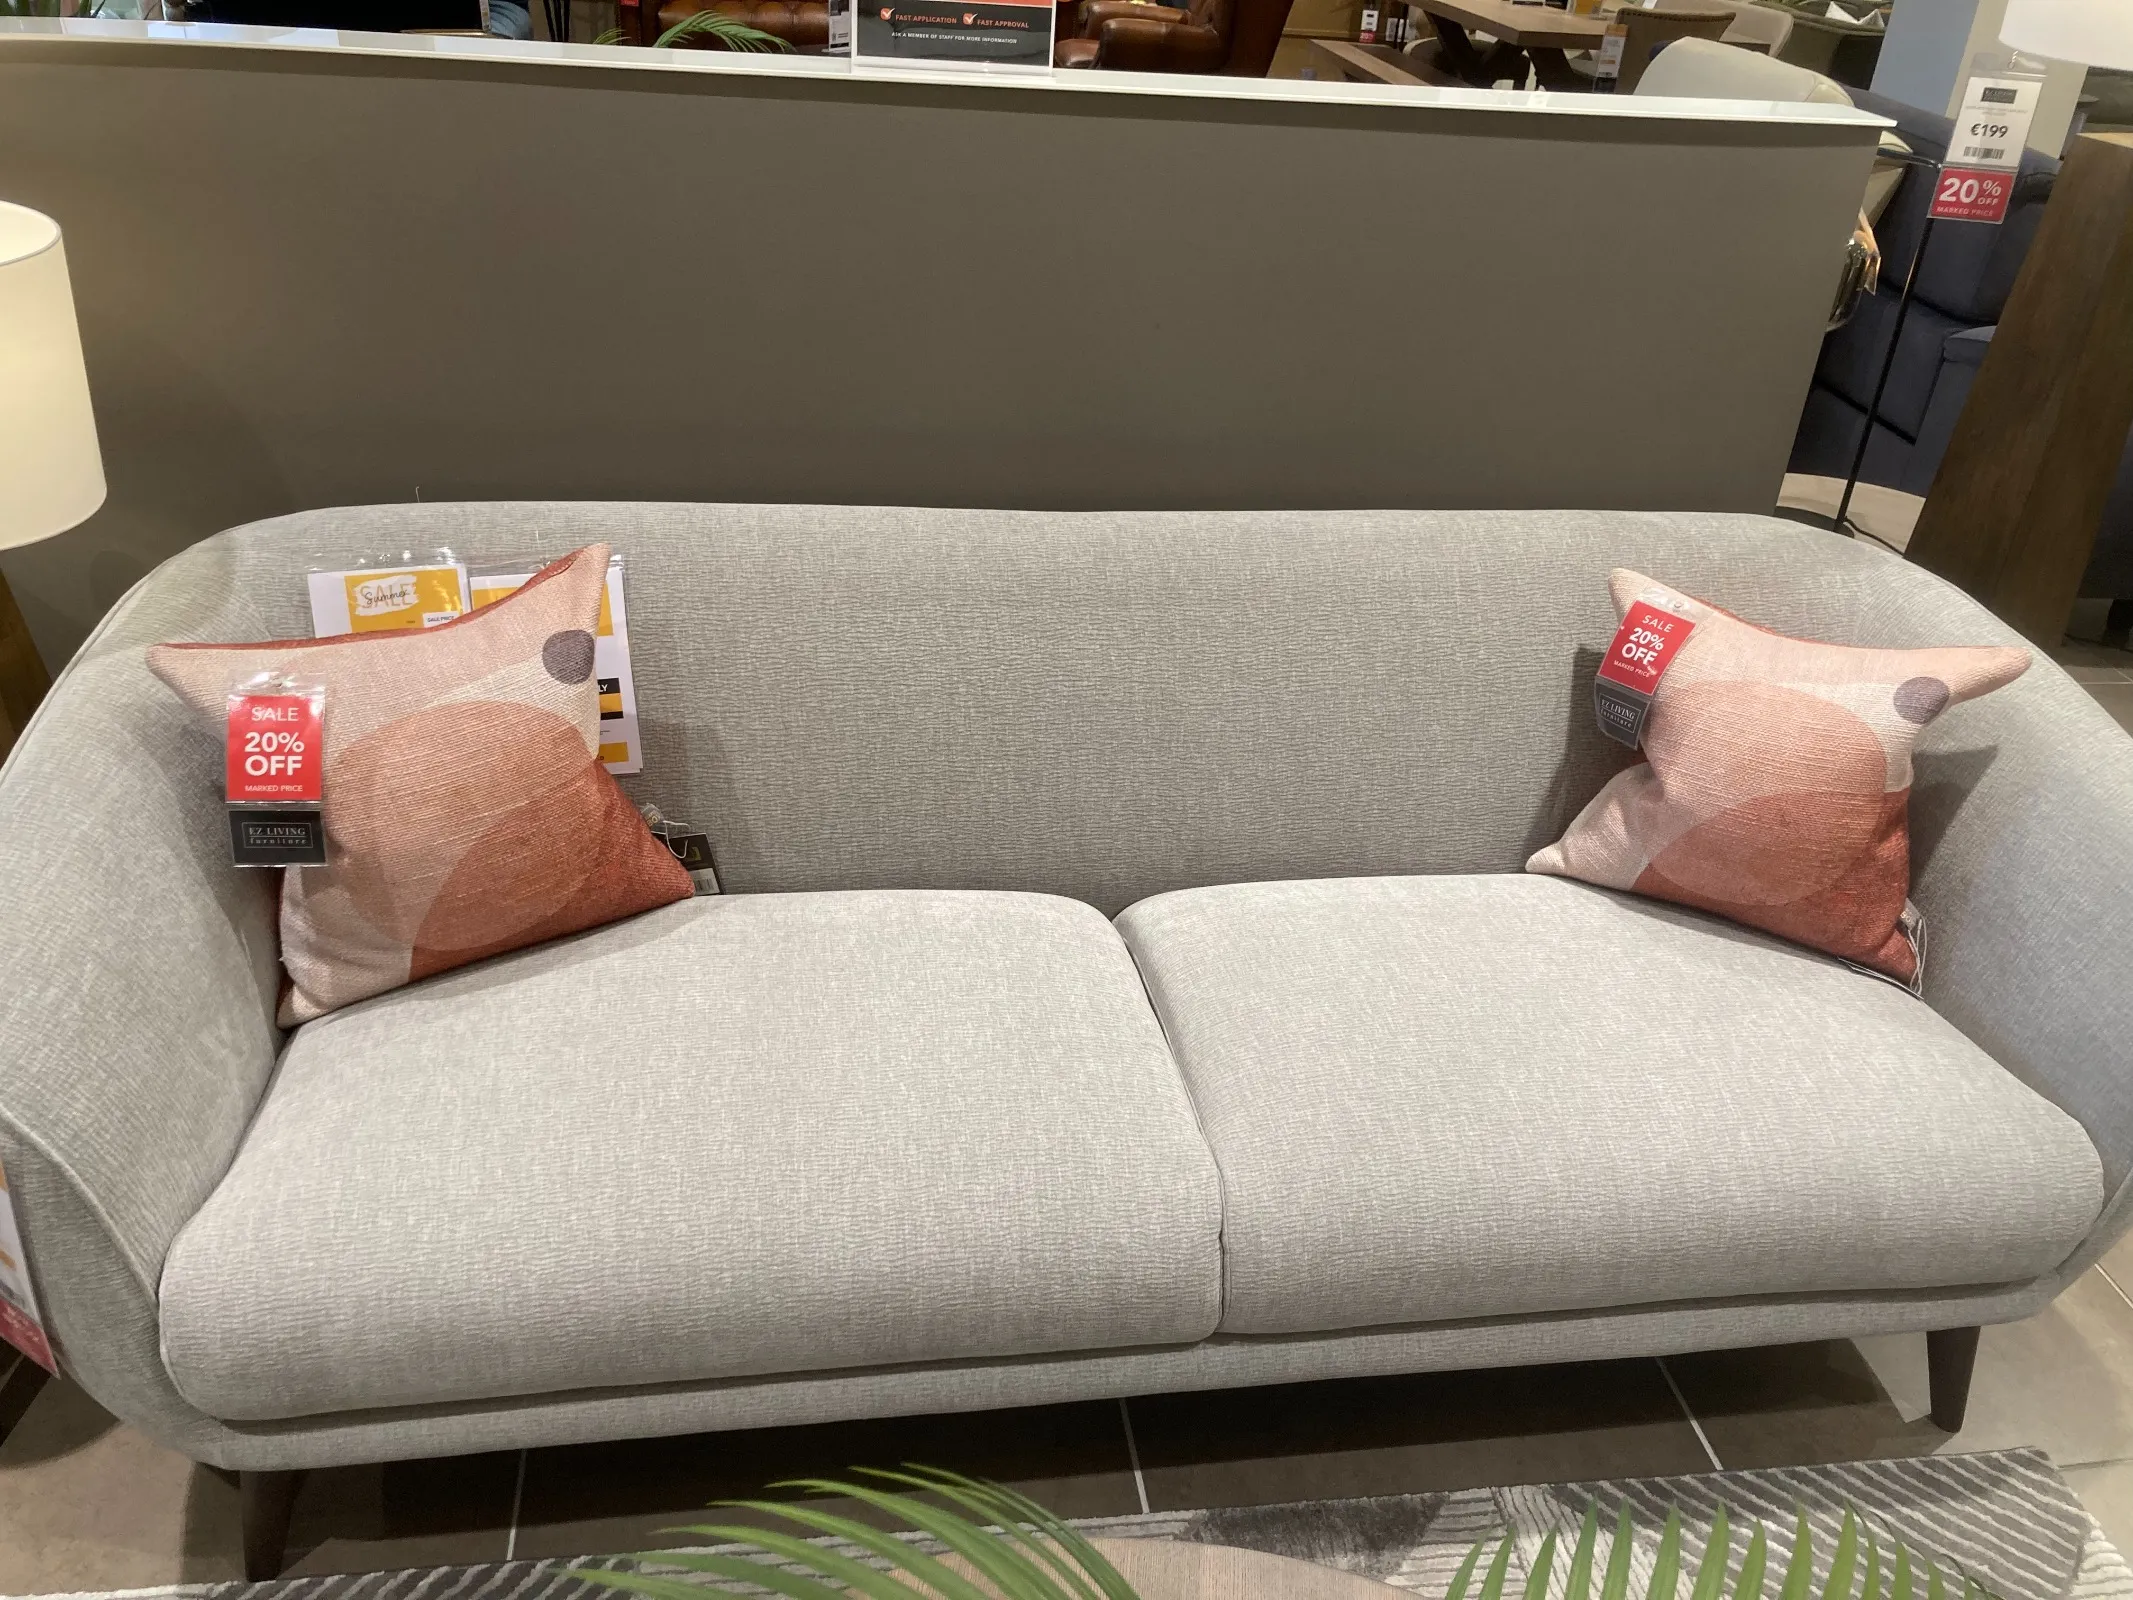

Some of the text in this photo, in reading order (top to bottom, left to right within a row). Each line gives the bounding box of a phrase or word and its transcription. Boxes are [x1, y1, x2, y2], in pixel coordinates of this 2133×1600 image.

[895, 14, 957, 24] FAST APPLICATION
[977, 18, 1029, 29] FAST APPROVAL
[1971, 123, 2008, 138] €199
[1977, 196, 1999, 206] OFF
[1936, 206, 1993, 217] MARKED PRICE
[1642, 614, 1675, 633] SALE
[1629, 627, 1664, 651] 20%
[1621, 643, 1659, 665] OFF
[1613, 659, 1651, 678] MARKED PRICE
[251, 707, 300, 722] SALE
[1610, 703, 1636, 720] LIVING
[244, 731, 305, 753] 20%
[244, 755, 303, 776] OFF
[244, 784, 303, 792] MARKED PRICE
[249, 827, 306, 836] EZ LIVING
[250, 837, 306, 845] furniture
